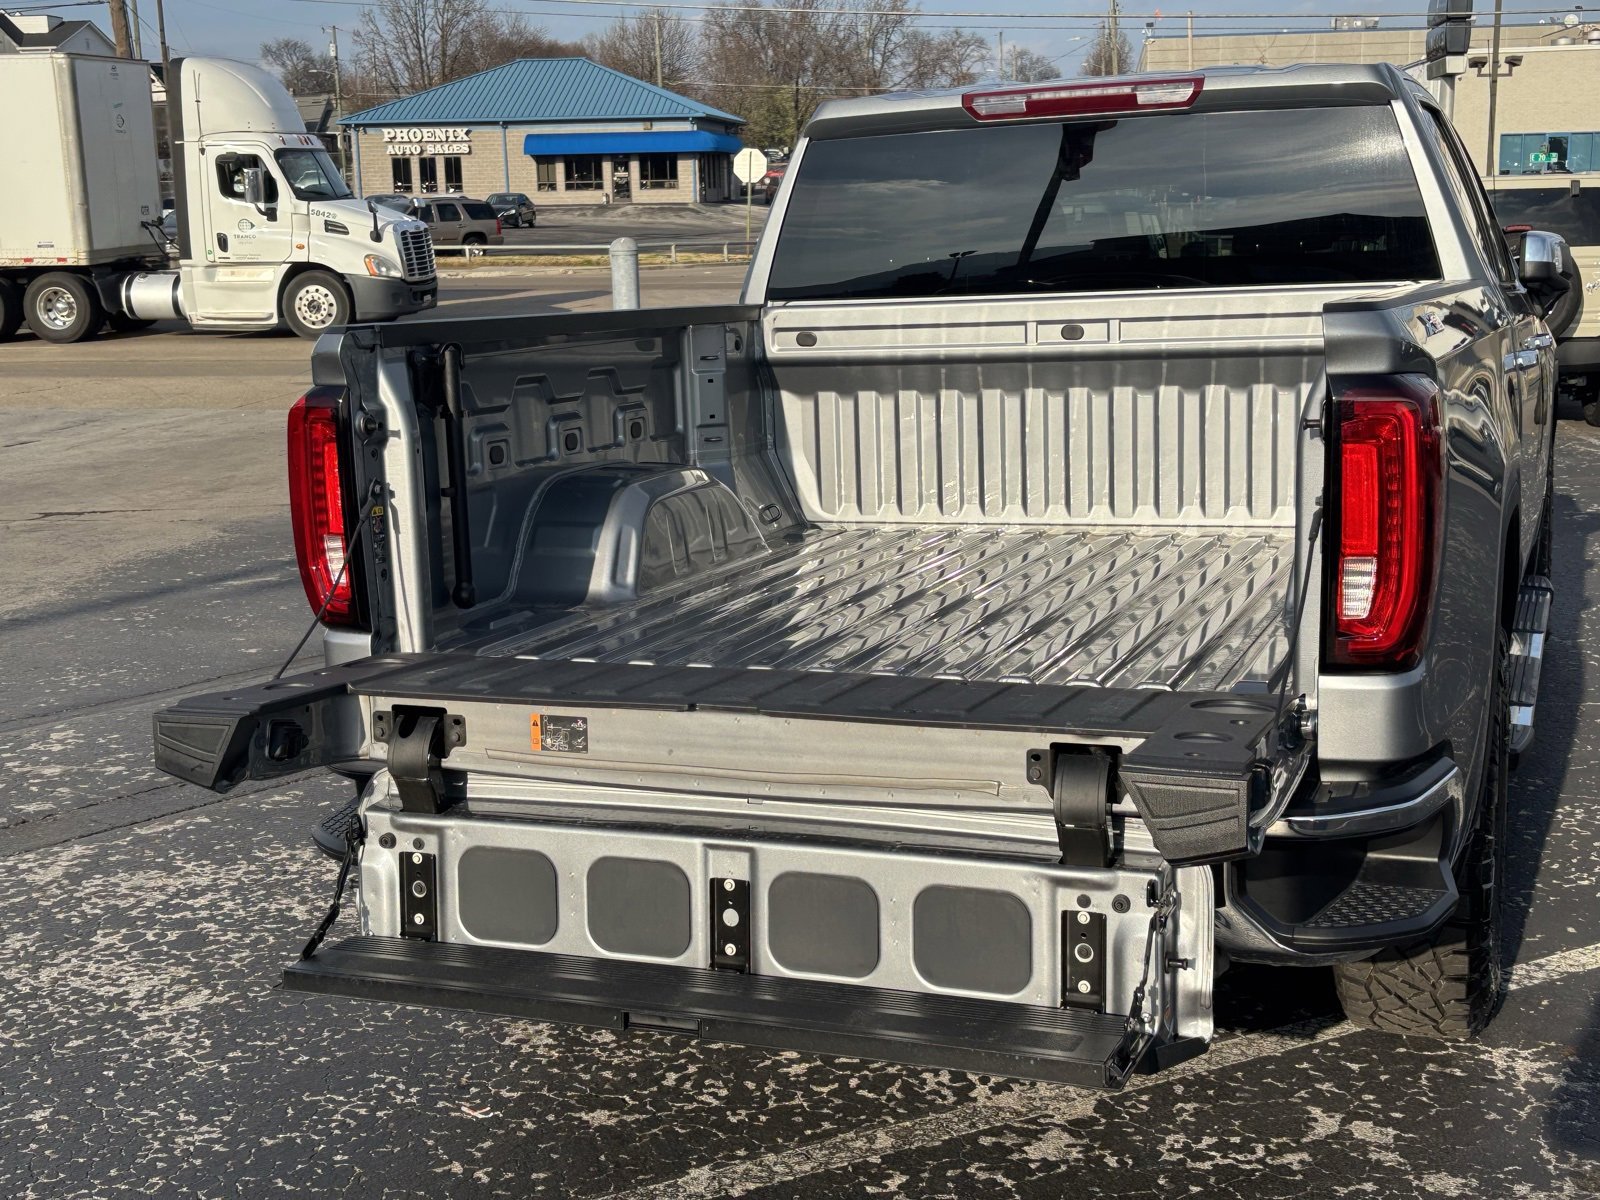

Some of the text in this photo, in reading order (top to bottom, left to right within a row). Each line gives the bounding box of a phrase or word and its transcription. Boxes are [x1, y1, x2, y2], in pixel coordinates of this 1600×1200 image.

[382, 128, 471, 142] PHOENIX
[386, 143, 470, 154] AUTO SALES
